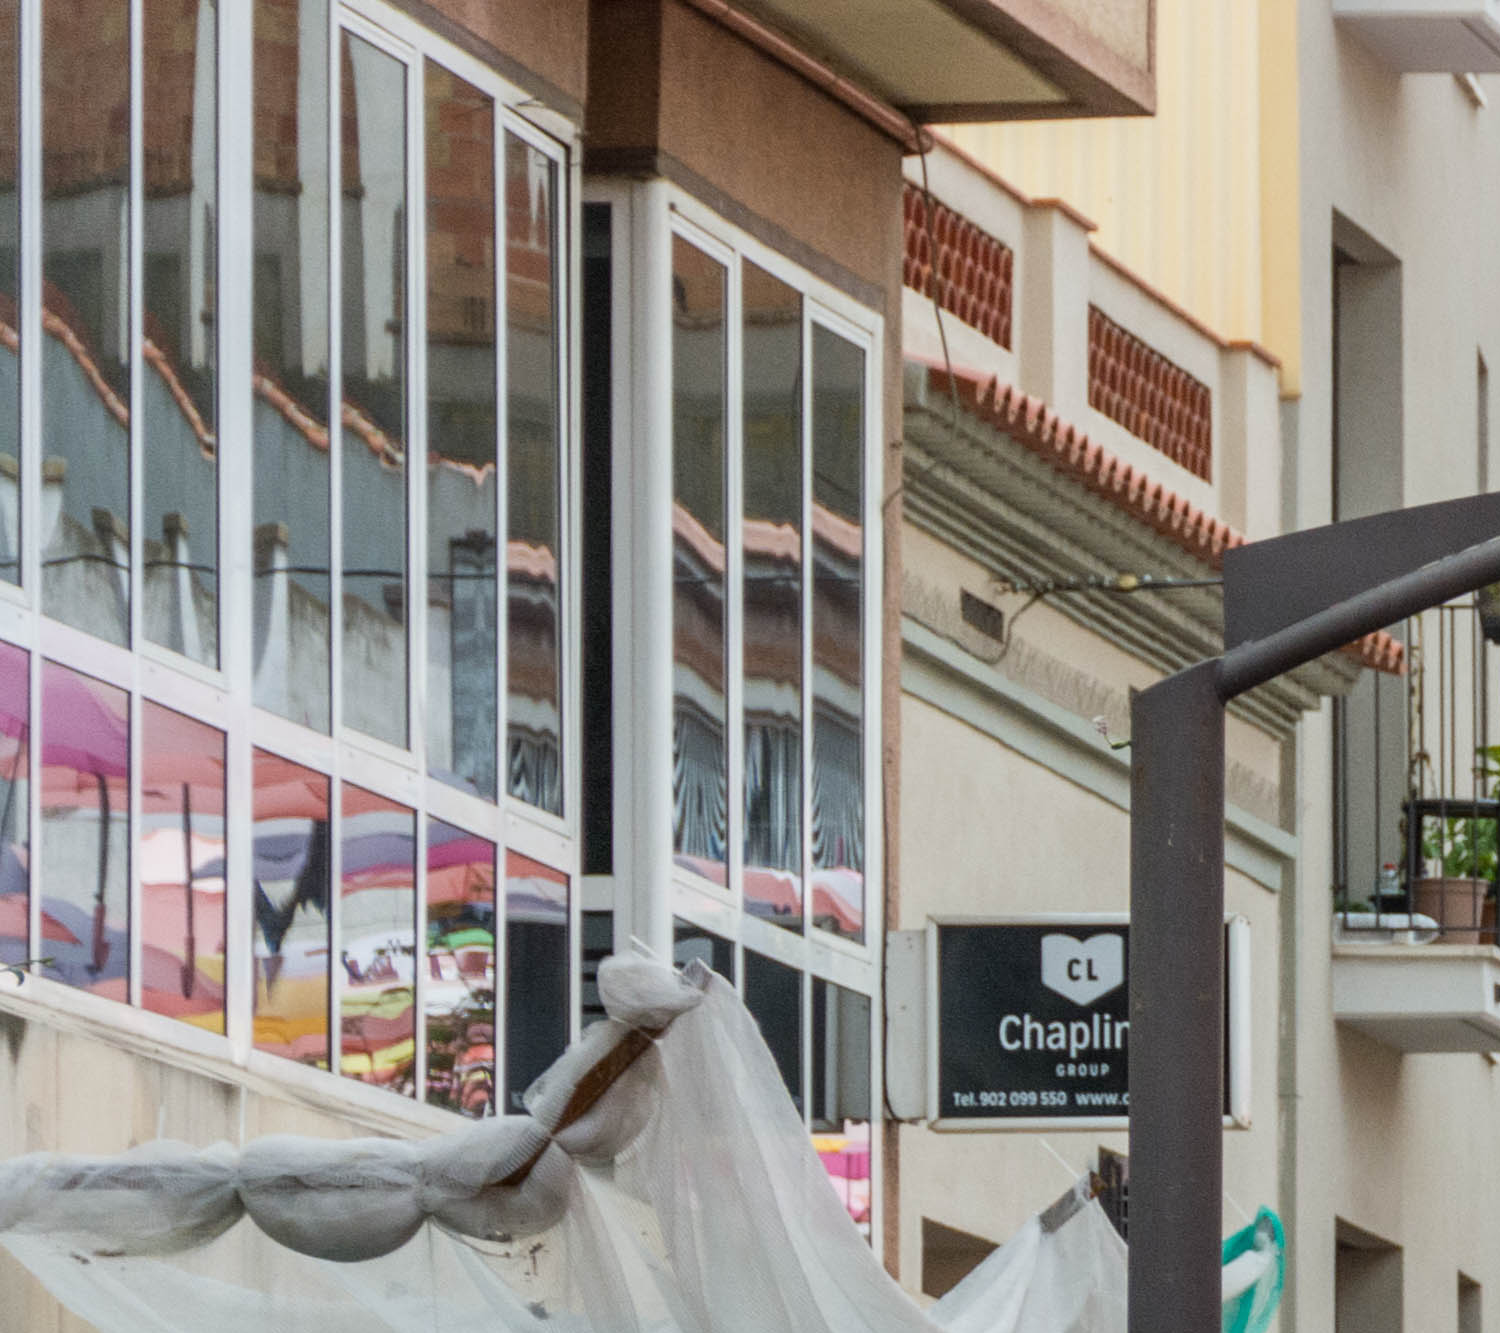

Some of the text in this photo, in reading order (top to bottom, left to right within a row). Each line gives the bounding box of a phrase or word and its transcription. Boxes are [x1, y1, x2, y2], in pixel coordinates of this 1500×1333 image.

[999, 1013, 1130, 1059] Chaplin
[1055, 1063, 1110, 1077] GROUP
[953, 1091, 977, 1107] Tel.
[979, 1091, 1007, 1106] 902
[1009, 1091, 1038, 1106] 099
[1040, 1091, 1067, 1106] 550
